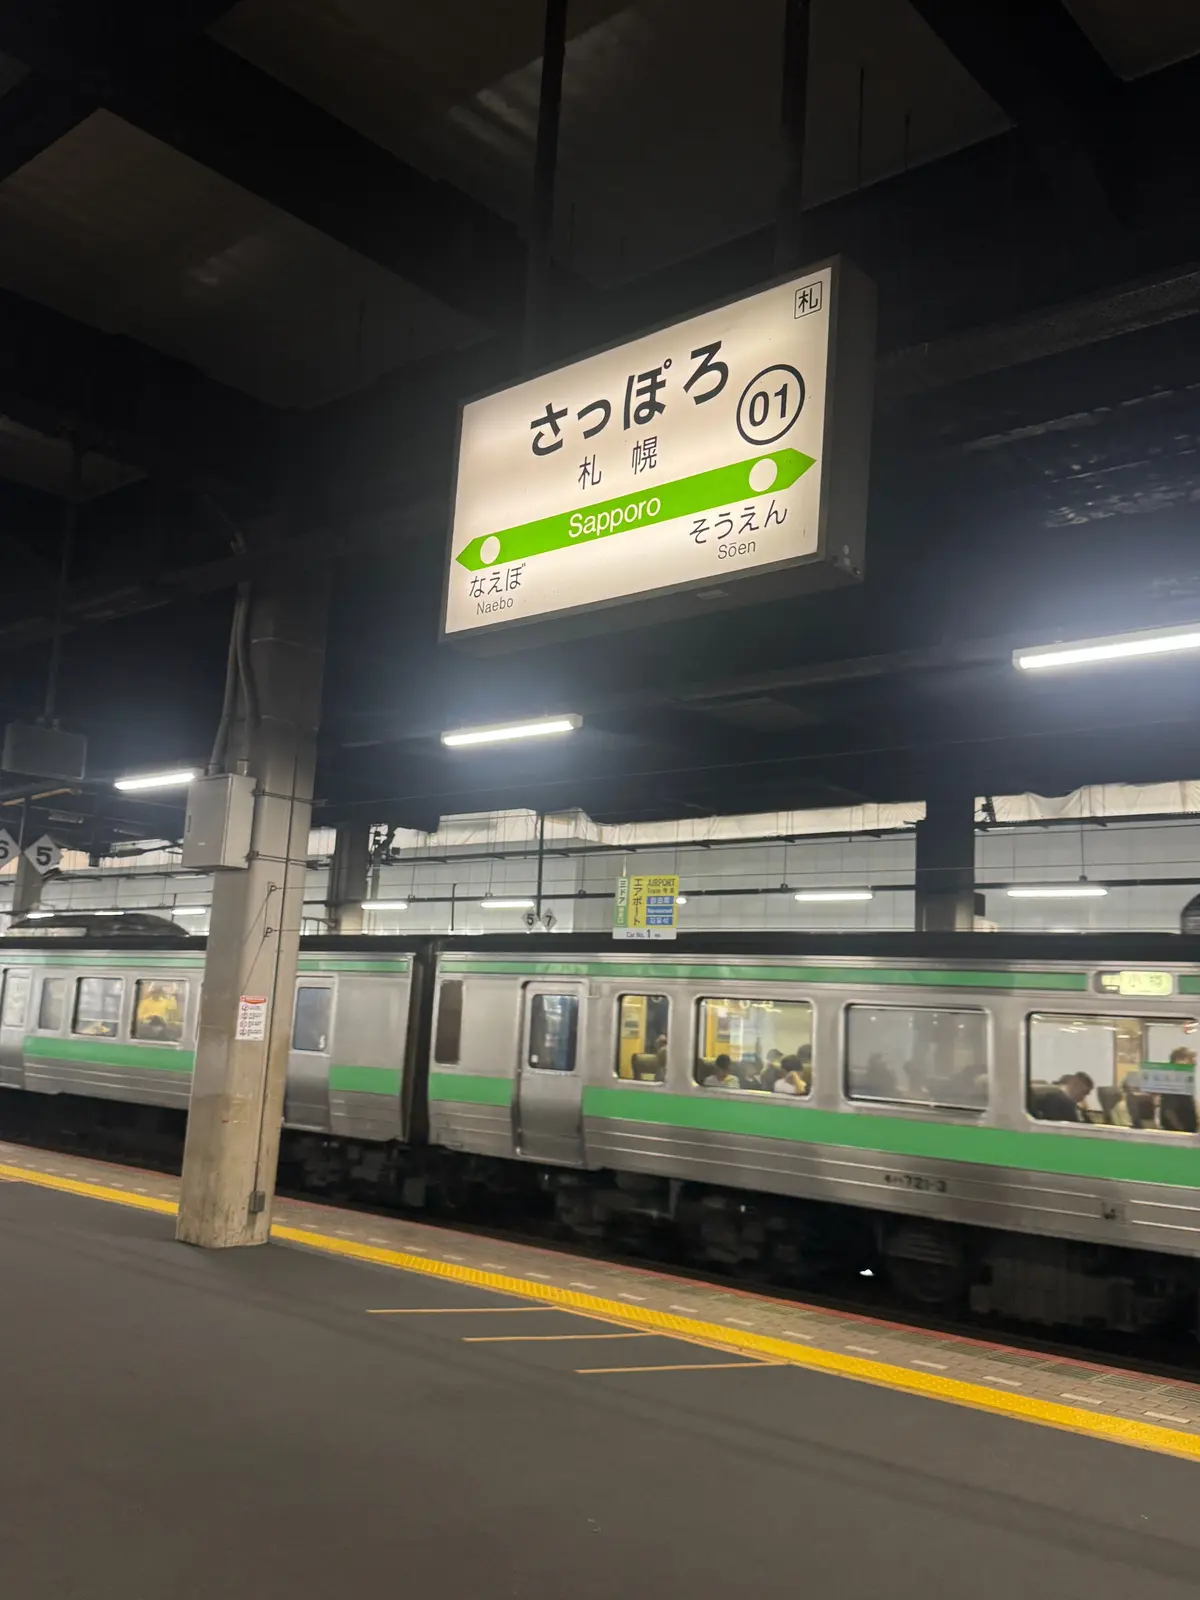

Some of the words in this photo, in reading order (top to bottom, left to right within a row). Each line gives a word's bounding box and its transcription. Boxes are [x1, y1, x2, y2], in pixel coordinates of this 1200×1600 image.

[798, 288, 818, 313] 札
[530, 340, 729, 456] さっぽろ
[748, 383, 788, 427] 01
[578, 436, 658, 489] 札幌
[568, 497, 661, 539] Sapporo
[689, 499, 788, 545] そうえん
[717, 540, 756, 560] Sōen
[469, 562, 527, 597] なえぼ
[476, 596, 514, 615] Naebo
[36, 846, 53, 866] 5
[647, 878, 676, 887] AIRPORT
[632, 878, 643, 926] エアポート
[526, 913, 535, 926] 5
[545, 915, 552, 927] 7
[646, 929, 651, 938] 1
